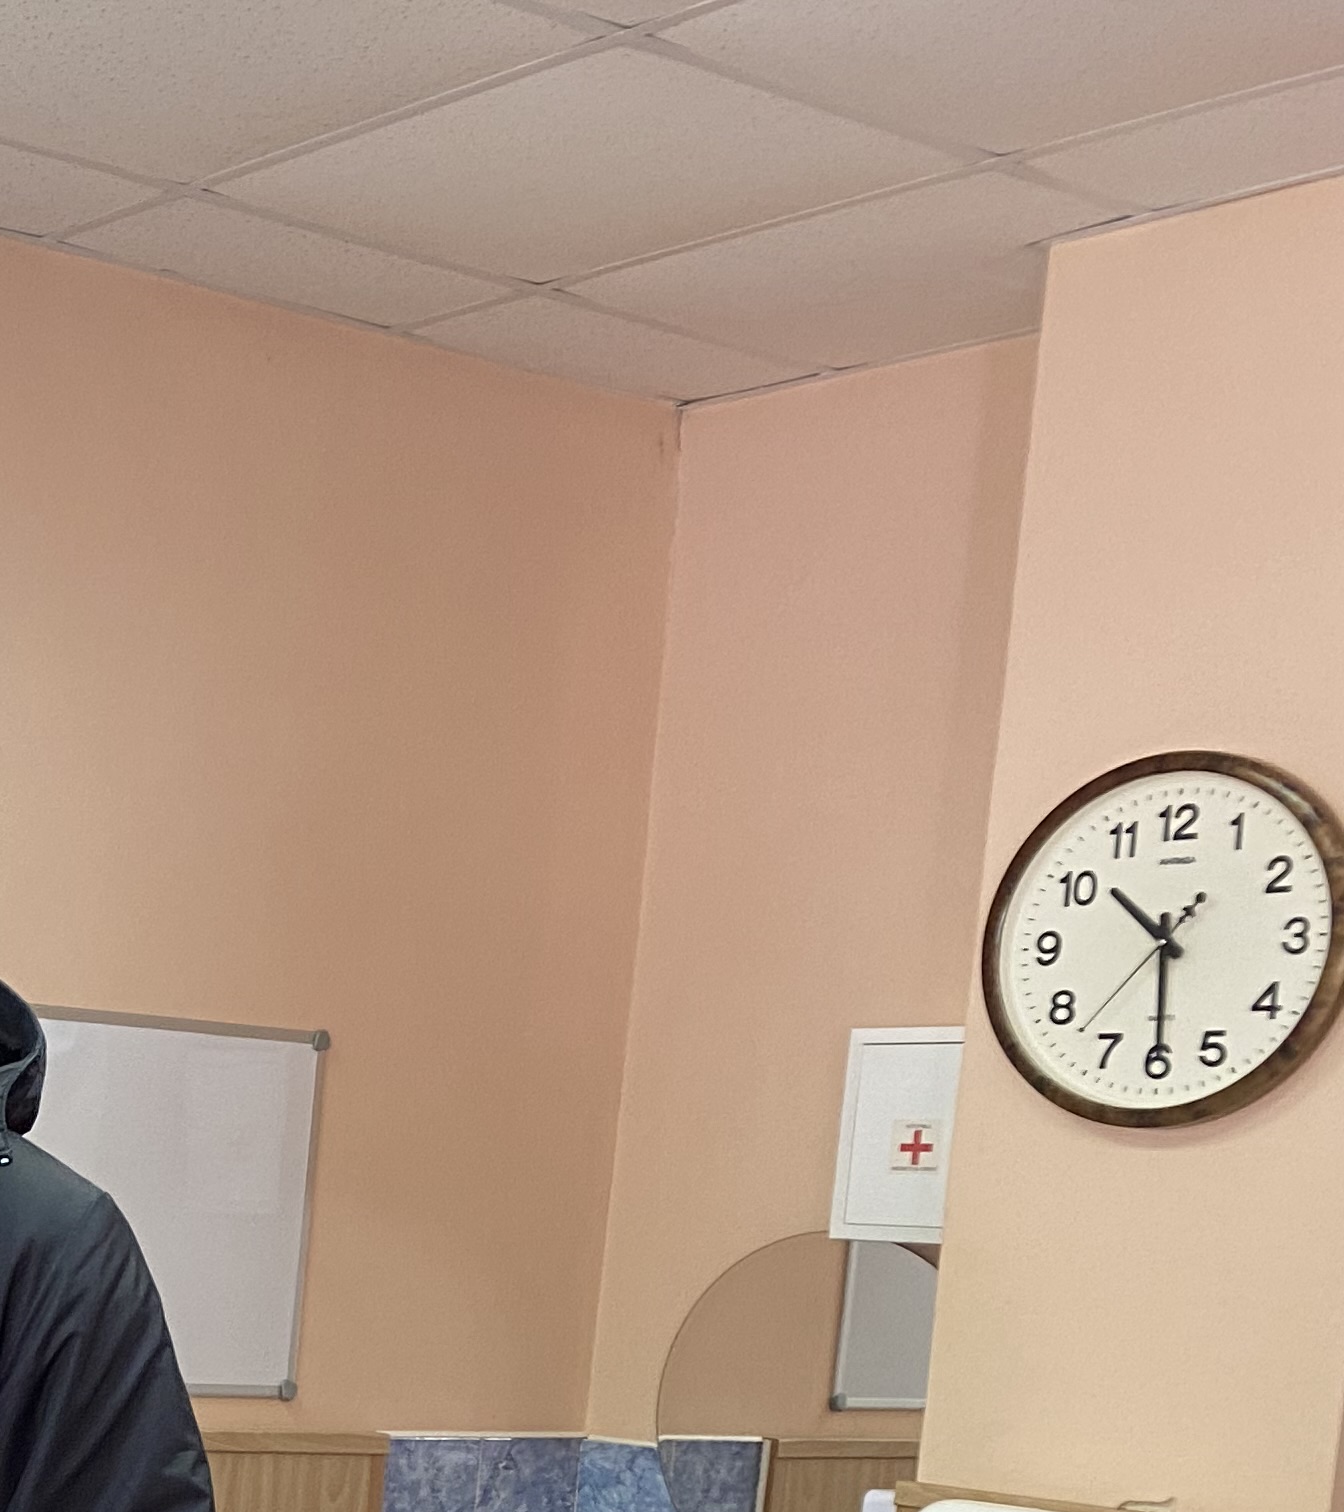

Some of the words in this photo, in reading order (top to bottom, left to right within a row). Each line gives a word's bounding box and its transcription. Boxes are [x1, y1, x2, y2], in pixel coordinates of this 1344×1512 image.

[1109, 821, 1140, 859] 11
[1158, 803, 1200, 841] 12
[1230, 812, 1246, 850] 1
[1059, 870, 1098, 907] 10
[1265, 855, 1294, 894] 2
[1036, 930, 1061, 966] 9
[1282, 916, 1311, 955] 3
[1049, 990, 1076, 1026] 8
[1251, 981, 1283, 1020] 4
[1097, 1032, 1124, 1069] 7
[1144, 1043, 1172, 1079] 6
[1198, 1029, 1229, 1068] 5
